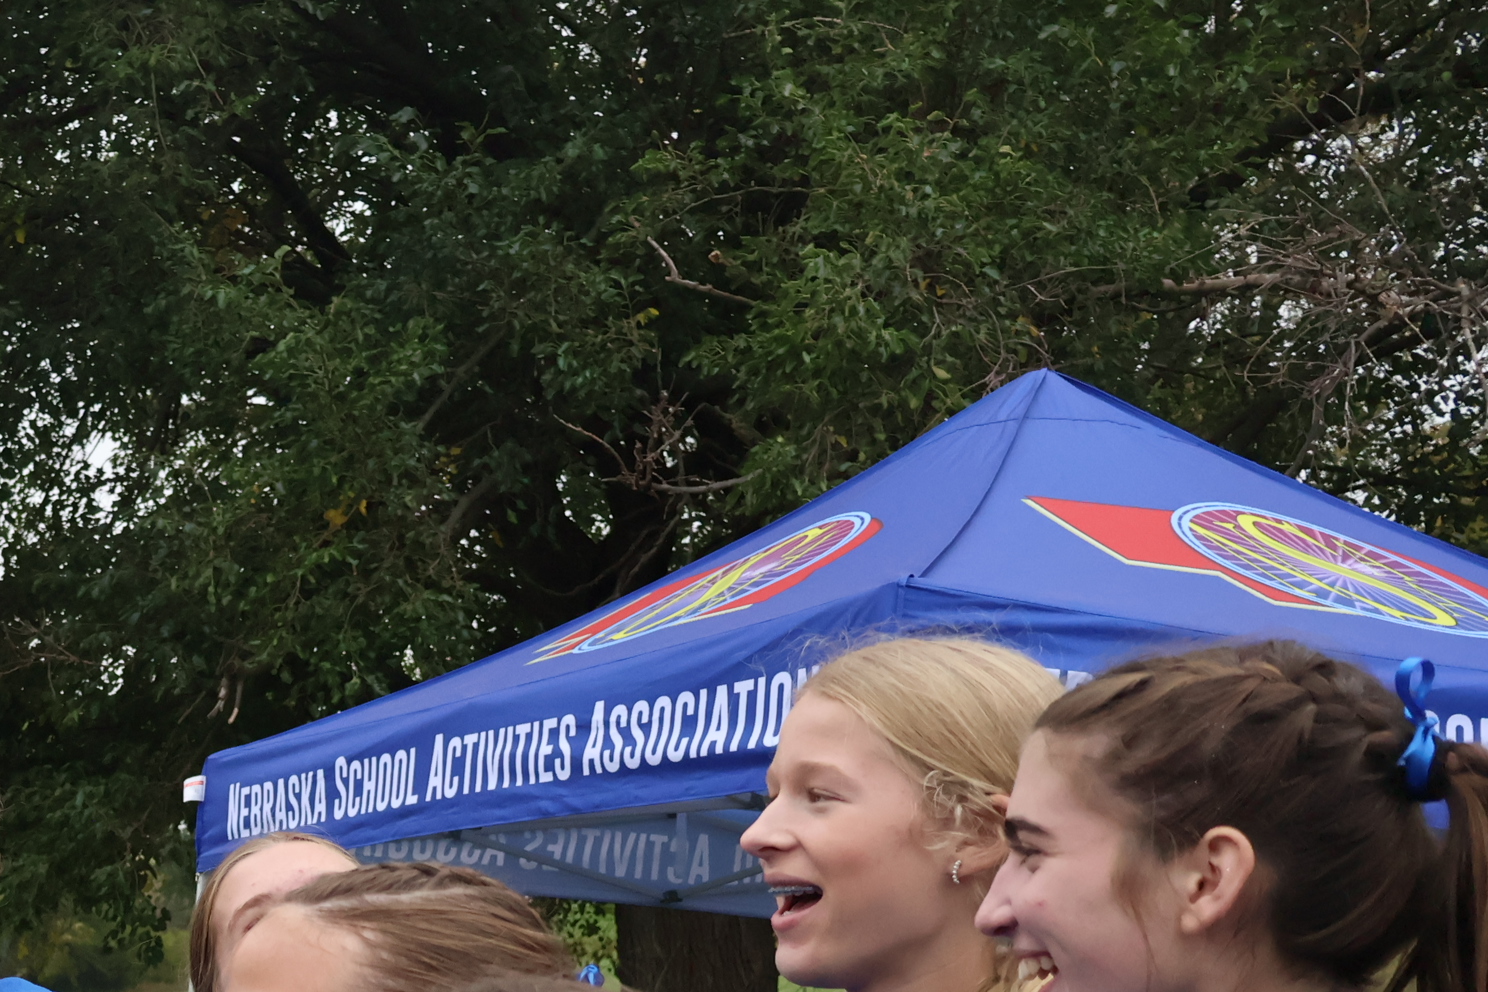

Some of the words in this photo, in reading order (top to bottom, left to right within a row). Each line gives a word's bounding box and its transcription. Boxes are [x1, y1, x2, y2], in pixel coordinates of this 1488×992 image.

[227, 769, 326, 840] NEBRASKA
[334, 747, 418, 820] SCHOOL
[425, 713, 576, 802] ACTIVITIES
